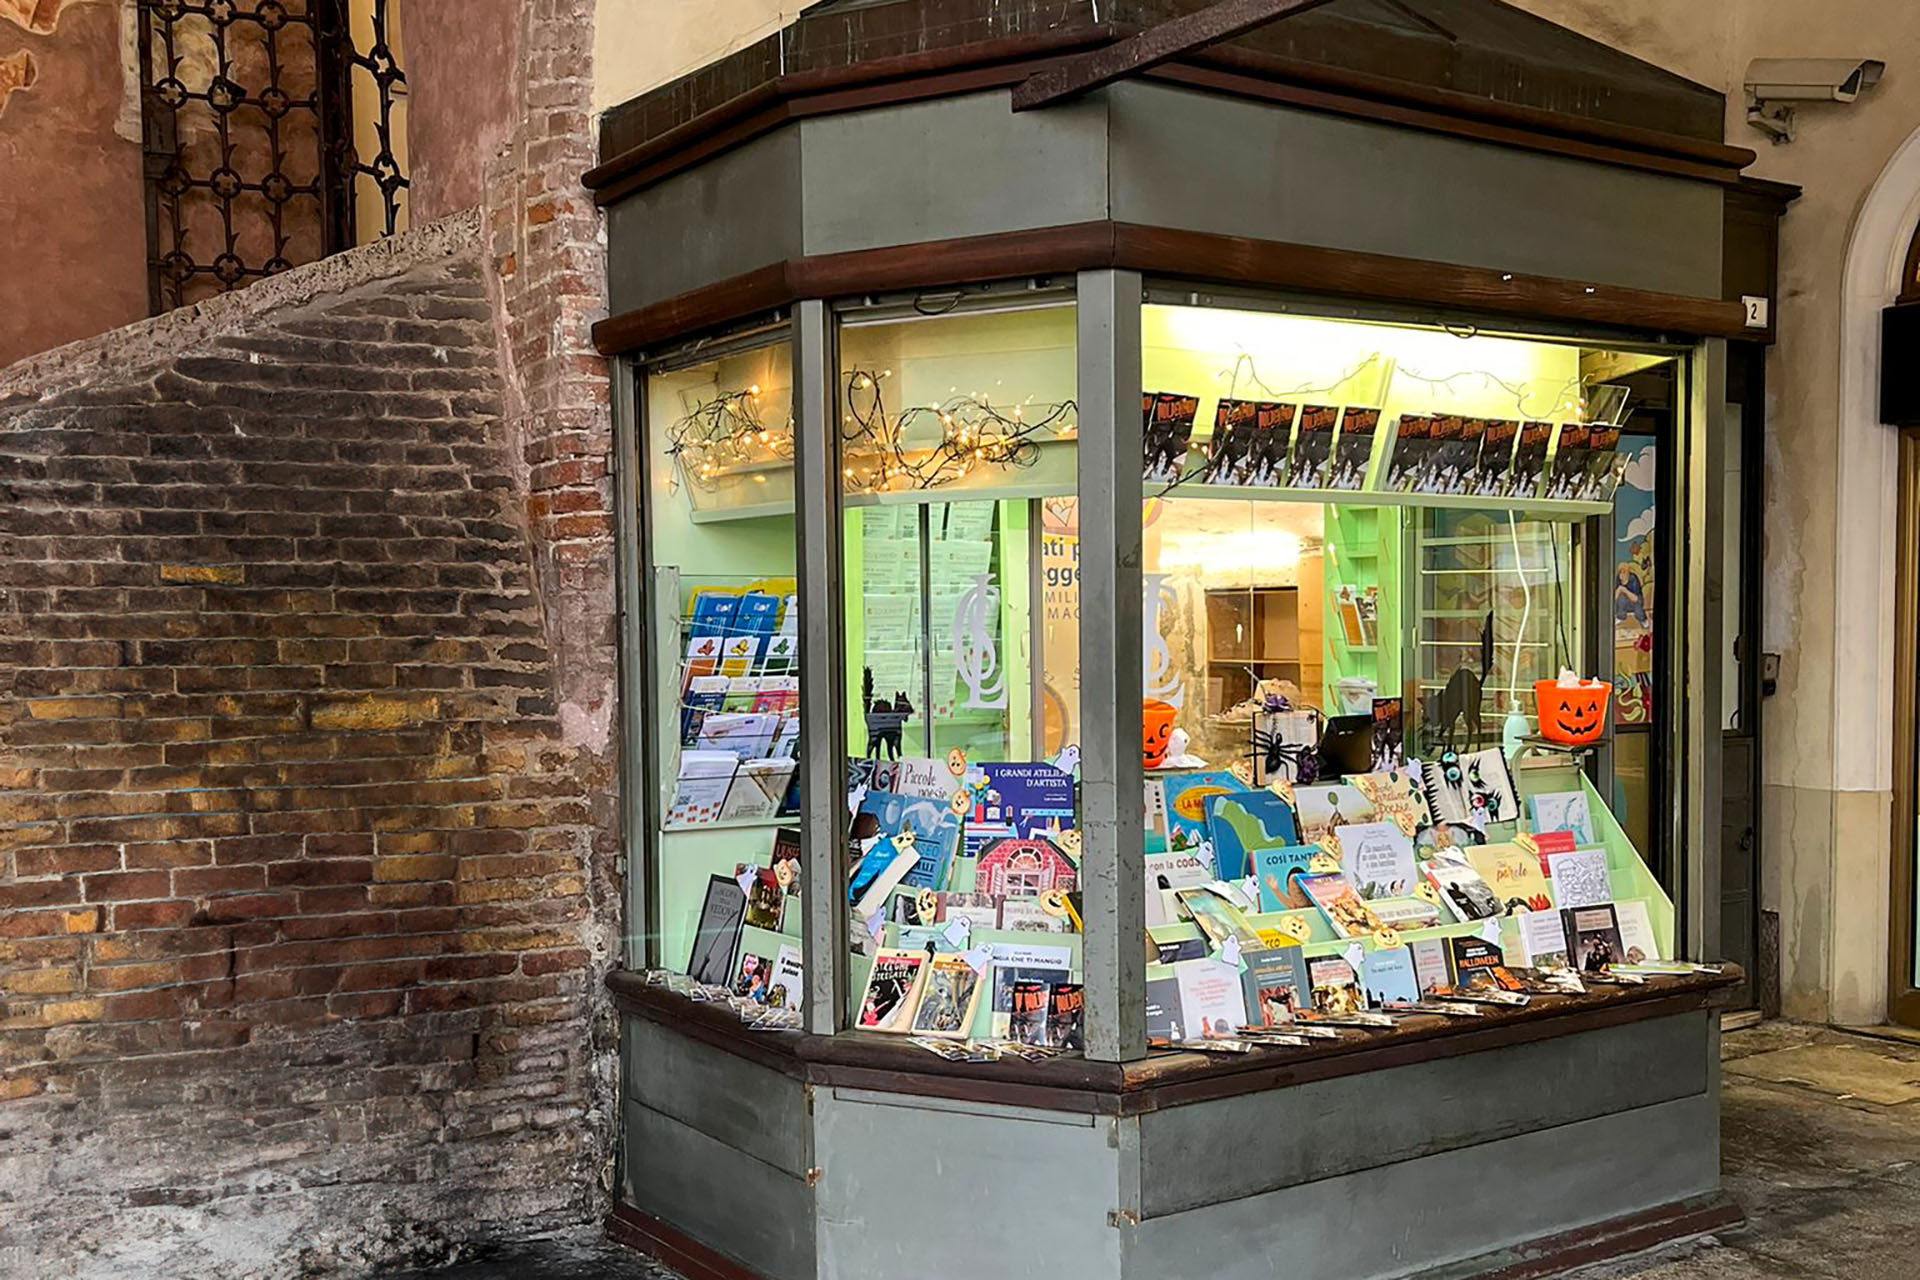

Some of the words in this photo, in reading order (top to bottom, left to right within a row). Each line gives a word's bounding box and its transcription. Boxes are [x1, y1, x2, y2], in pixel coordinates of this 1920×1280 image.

[1751, 303, 1757, 320] 2
[1045, 567, 1080, 588] gge
[904, 763, 937, 787] Piccole
[1000, 769, 1031, 778] GRANDI
[1026, 779, 1067, 788] D'ARTISTA
